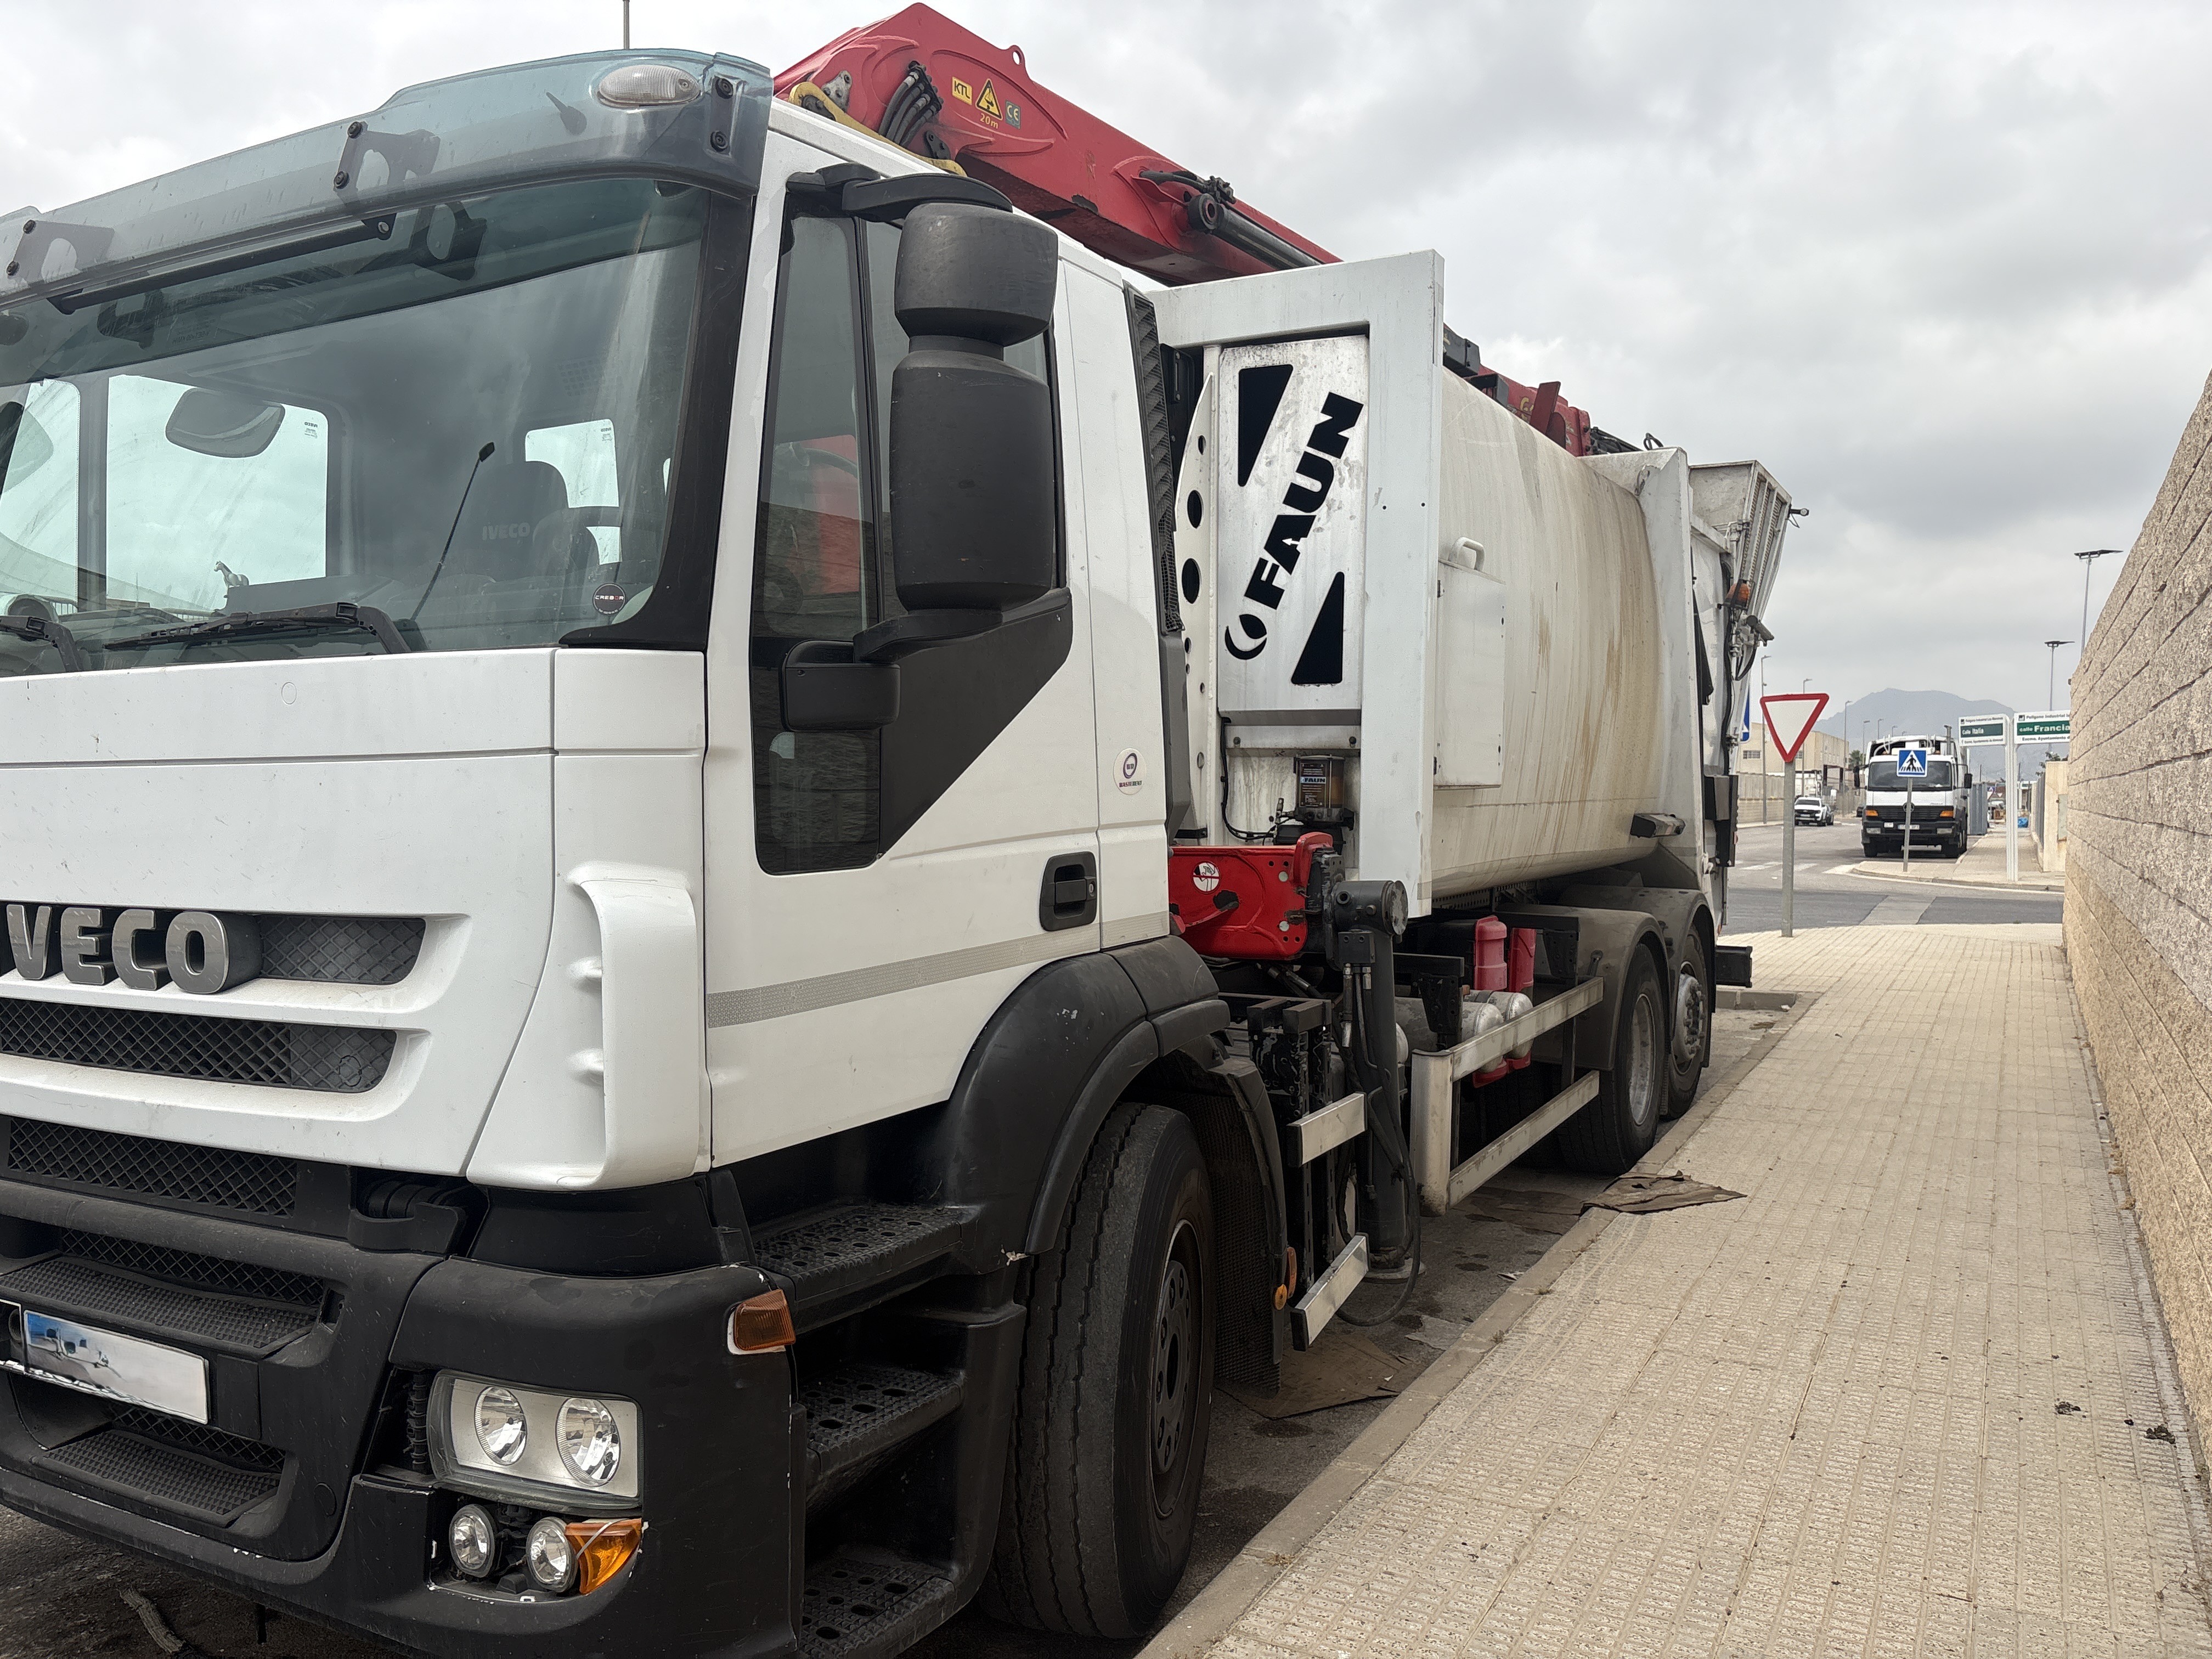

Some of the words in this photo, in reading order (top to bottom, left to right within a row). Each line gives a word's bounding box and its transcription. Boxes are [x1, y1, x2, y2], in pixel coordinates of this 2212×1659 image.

[954, 80, 970, 99] KTL
[1007, 104, 1019, 121] CE
[1244, 391, 1364, 610] FAUN
[483, 522, 531, 541] IVECO
[2034, 724, 2070, 732] Francia
[6, 904, 229, 994] VECO
